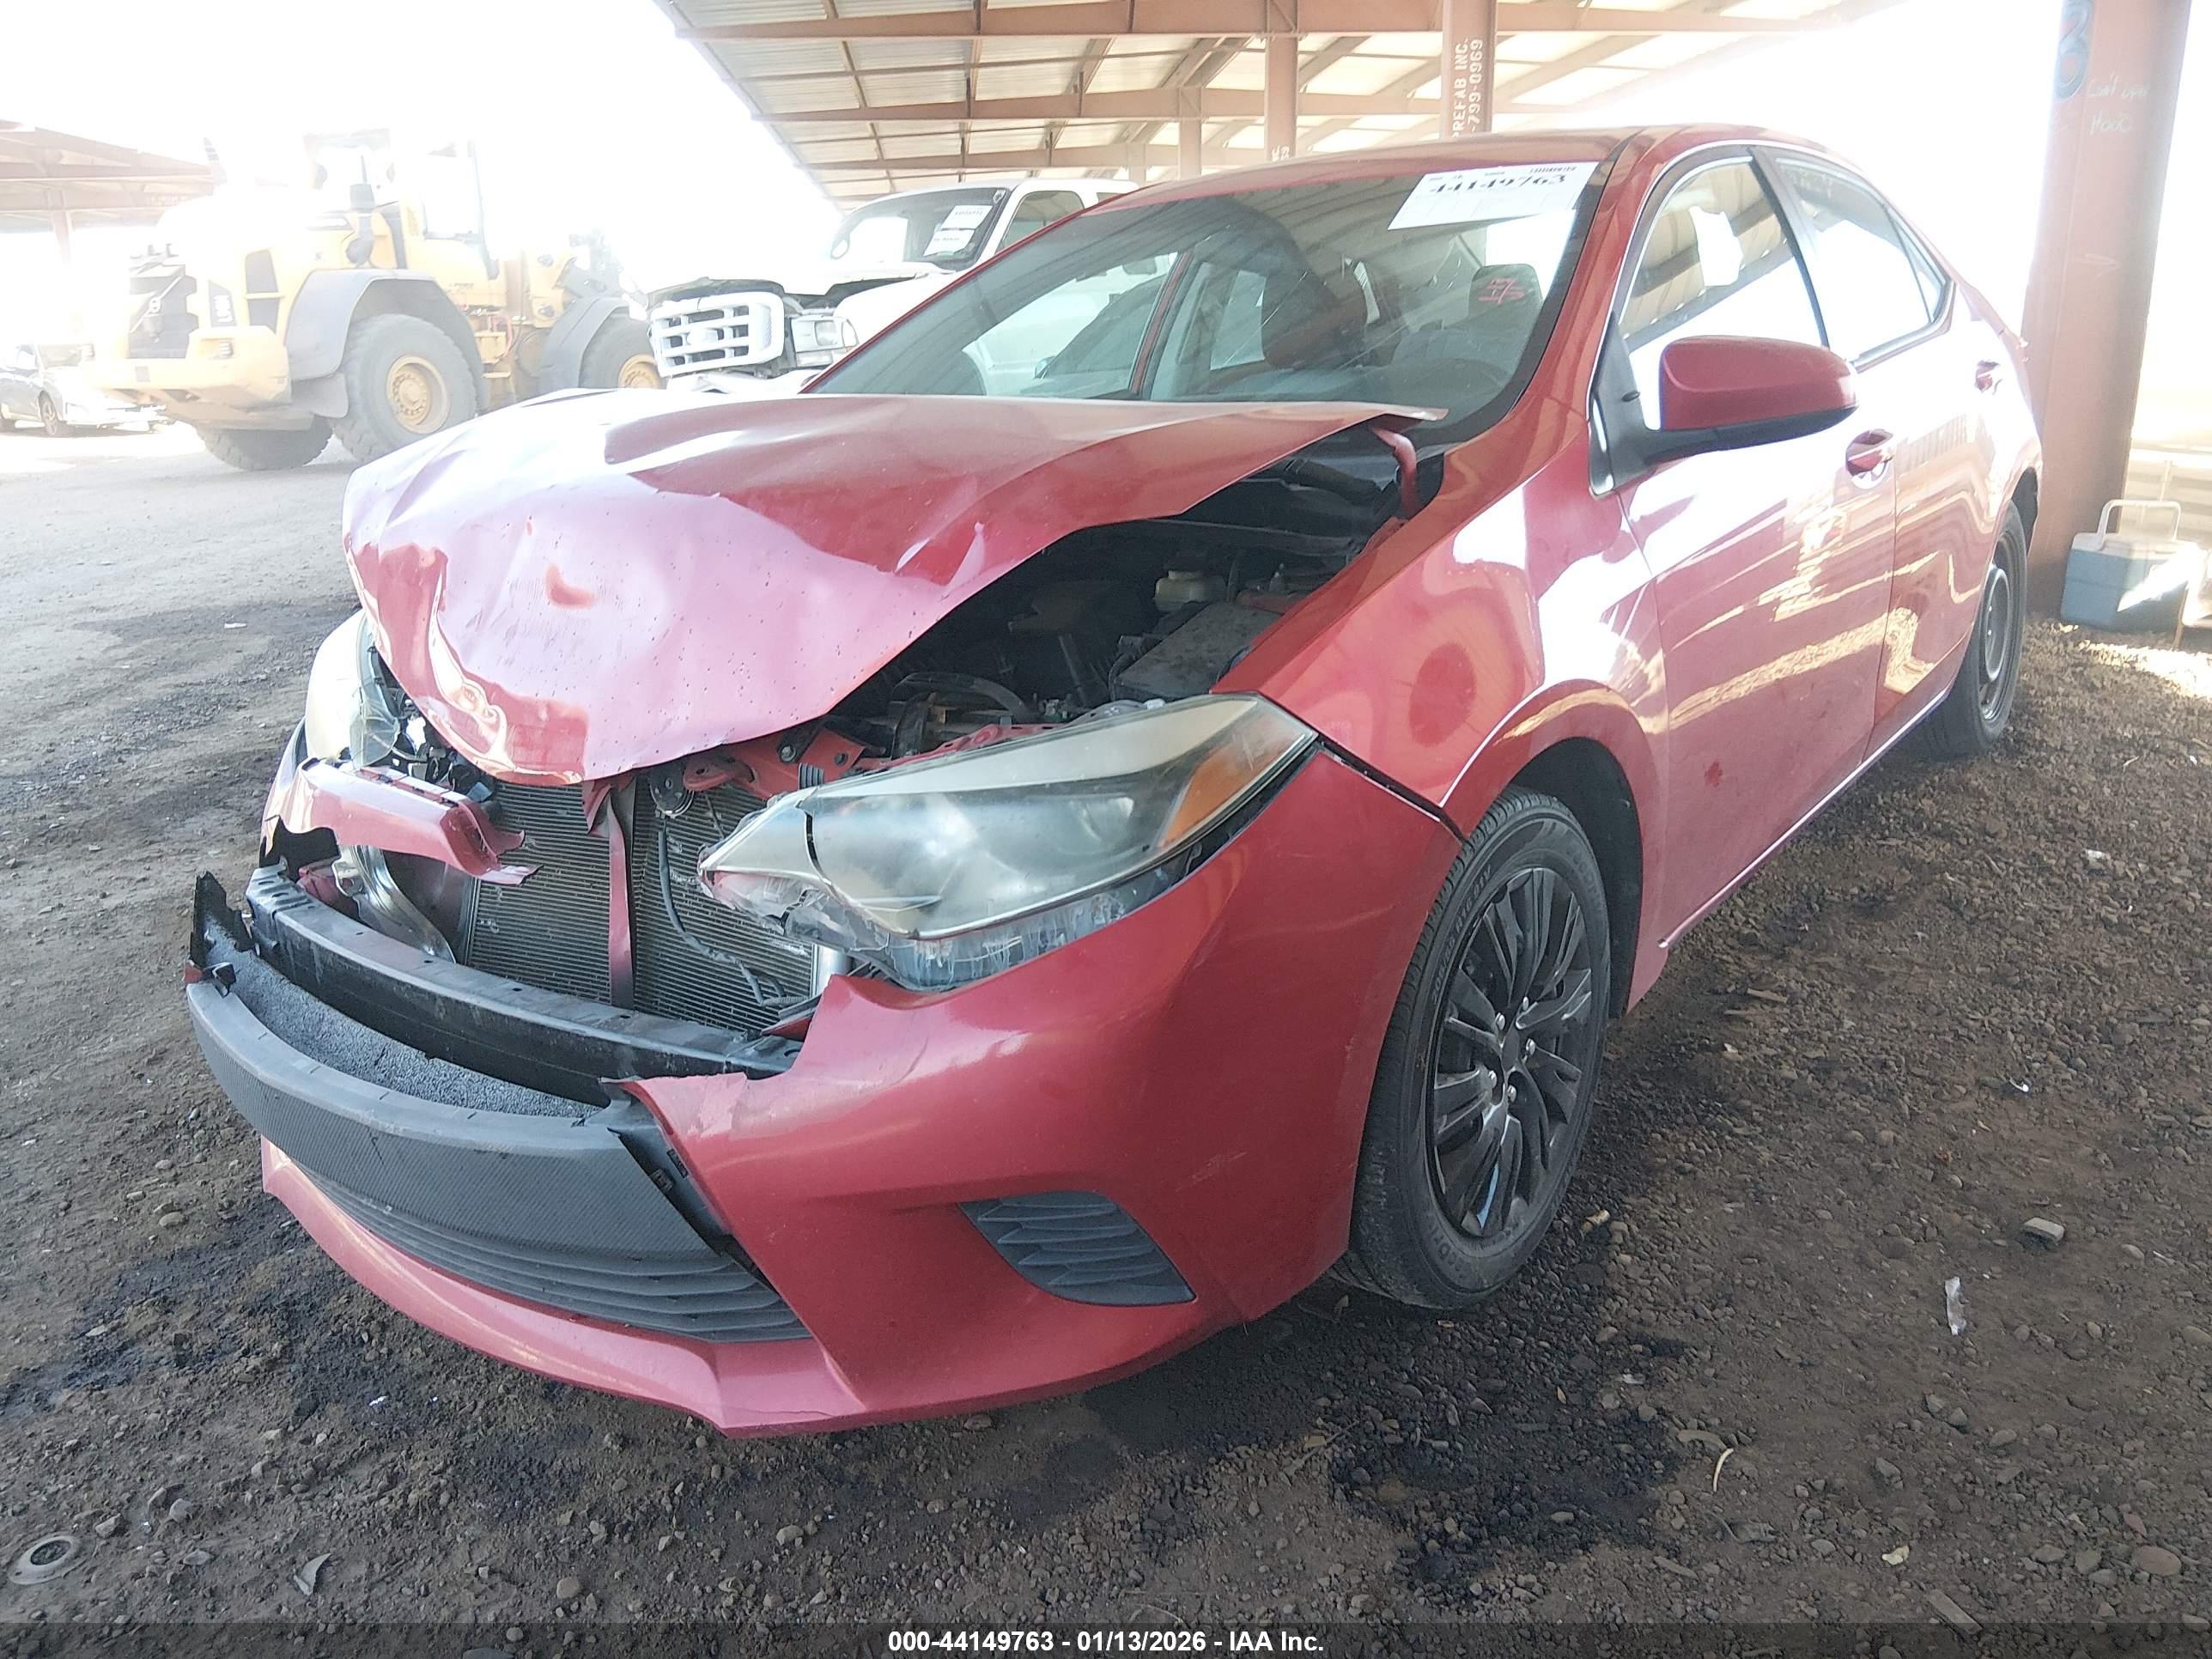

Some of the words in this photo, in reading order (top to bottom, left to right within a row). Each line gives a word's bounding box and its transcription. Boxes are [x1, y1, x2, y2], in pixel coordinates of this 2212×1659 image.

[1455, 38, 1469, 70] INC.
[1468, 39, 1484, 137] -799-0969
[1429, 173, 1566, 194] 44149763
